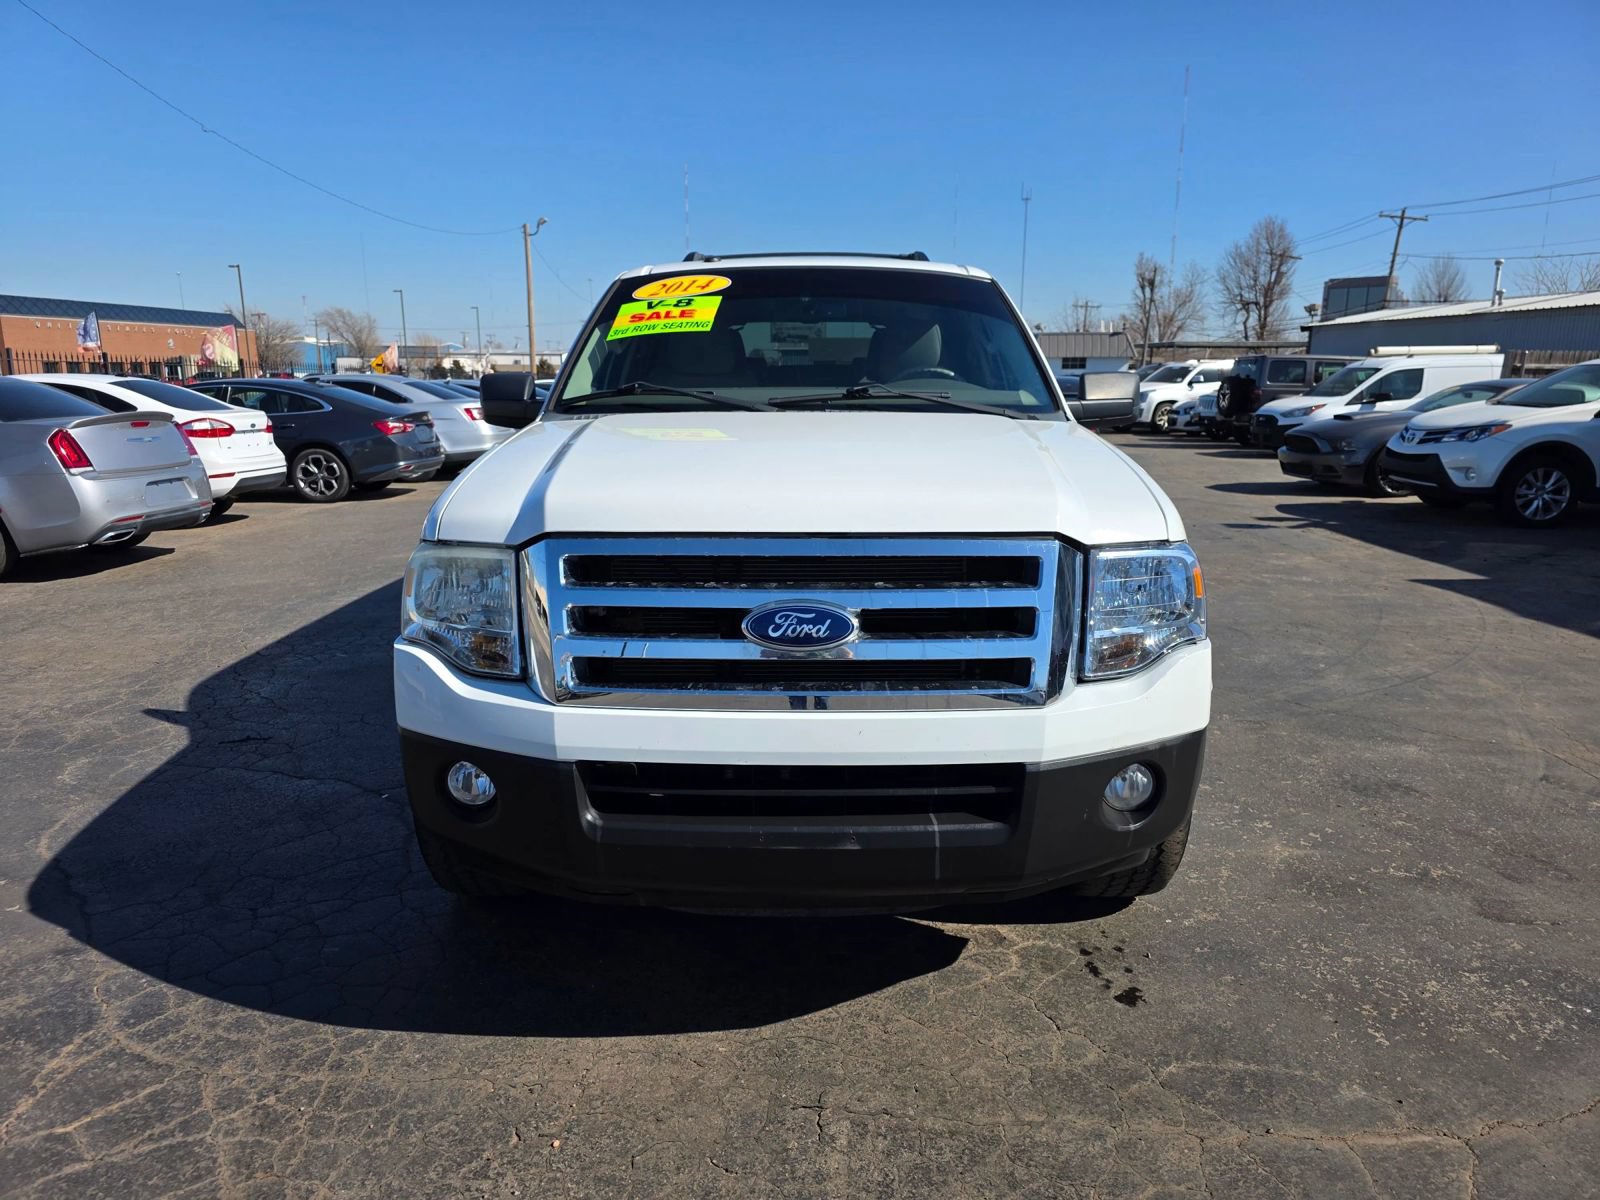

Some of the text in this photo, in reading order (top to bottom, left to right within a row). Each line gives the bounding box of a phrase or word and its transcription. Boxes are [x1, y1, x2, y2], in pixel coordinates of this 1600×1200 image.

[650, 279, 716, 296] 2014
[647, 298, 694, 309] V-8
[629, 310, 696, 322] SALE
[610, 321, 710, 337] 3rd ROW SEATING
[767, 611, 832, 638] Ford
